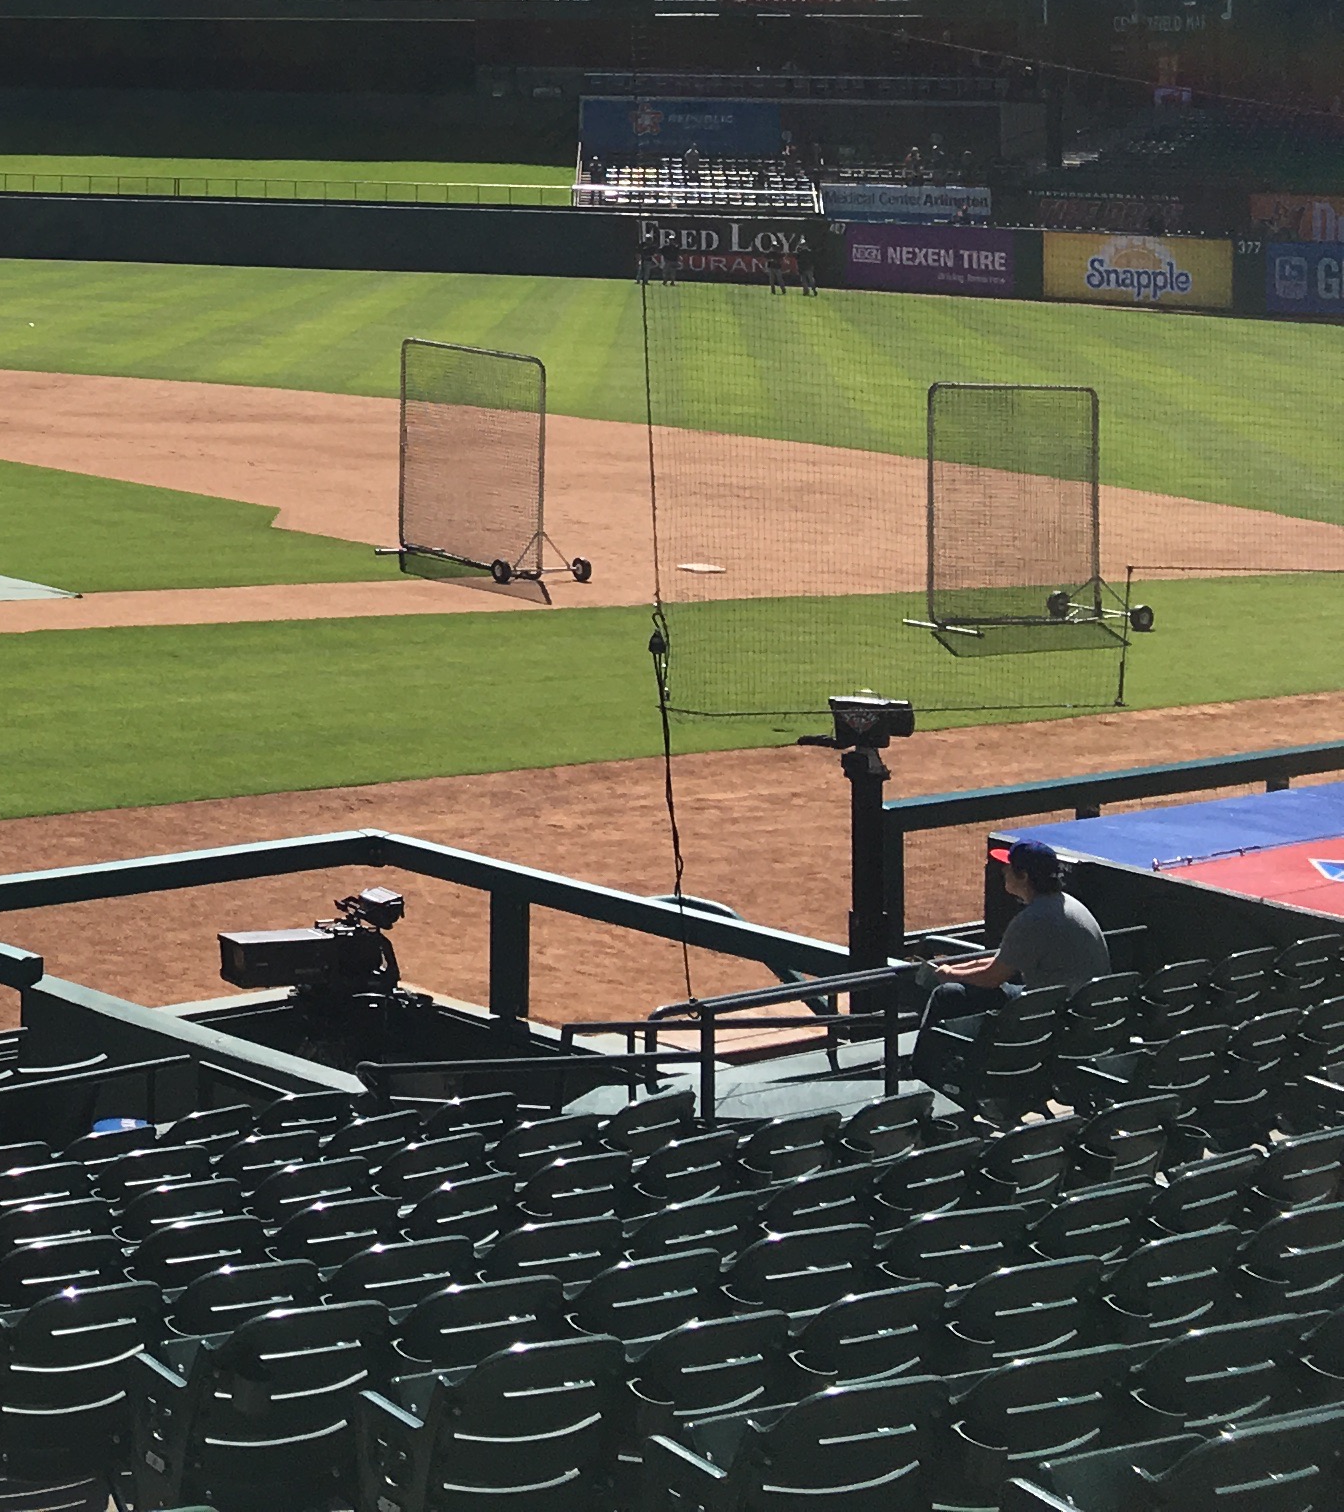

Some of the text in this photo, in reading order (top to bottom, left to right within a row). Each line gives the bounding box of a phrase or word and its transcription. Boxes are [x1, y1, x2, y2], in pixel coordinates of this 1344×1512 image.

[828, 191, 988, 209] Medical Center Arlington
[636, 219, 719, 252] FRED
[1238, 240, 1261, 255] 377
[887, 246, 954, 268] NEXEN
[960, 249, 1007, 271] TIRE
[1087, 258, 1191, 300] Snapple
[1318, 257, 1344, 299] G
